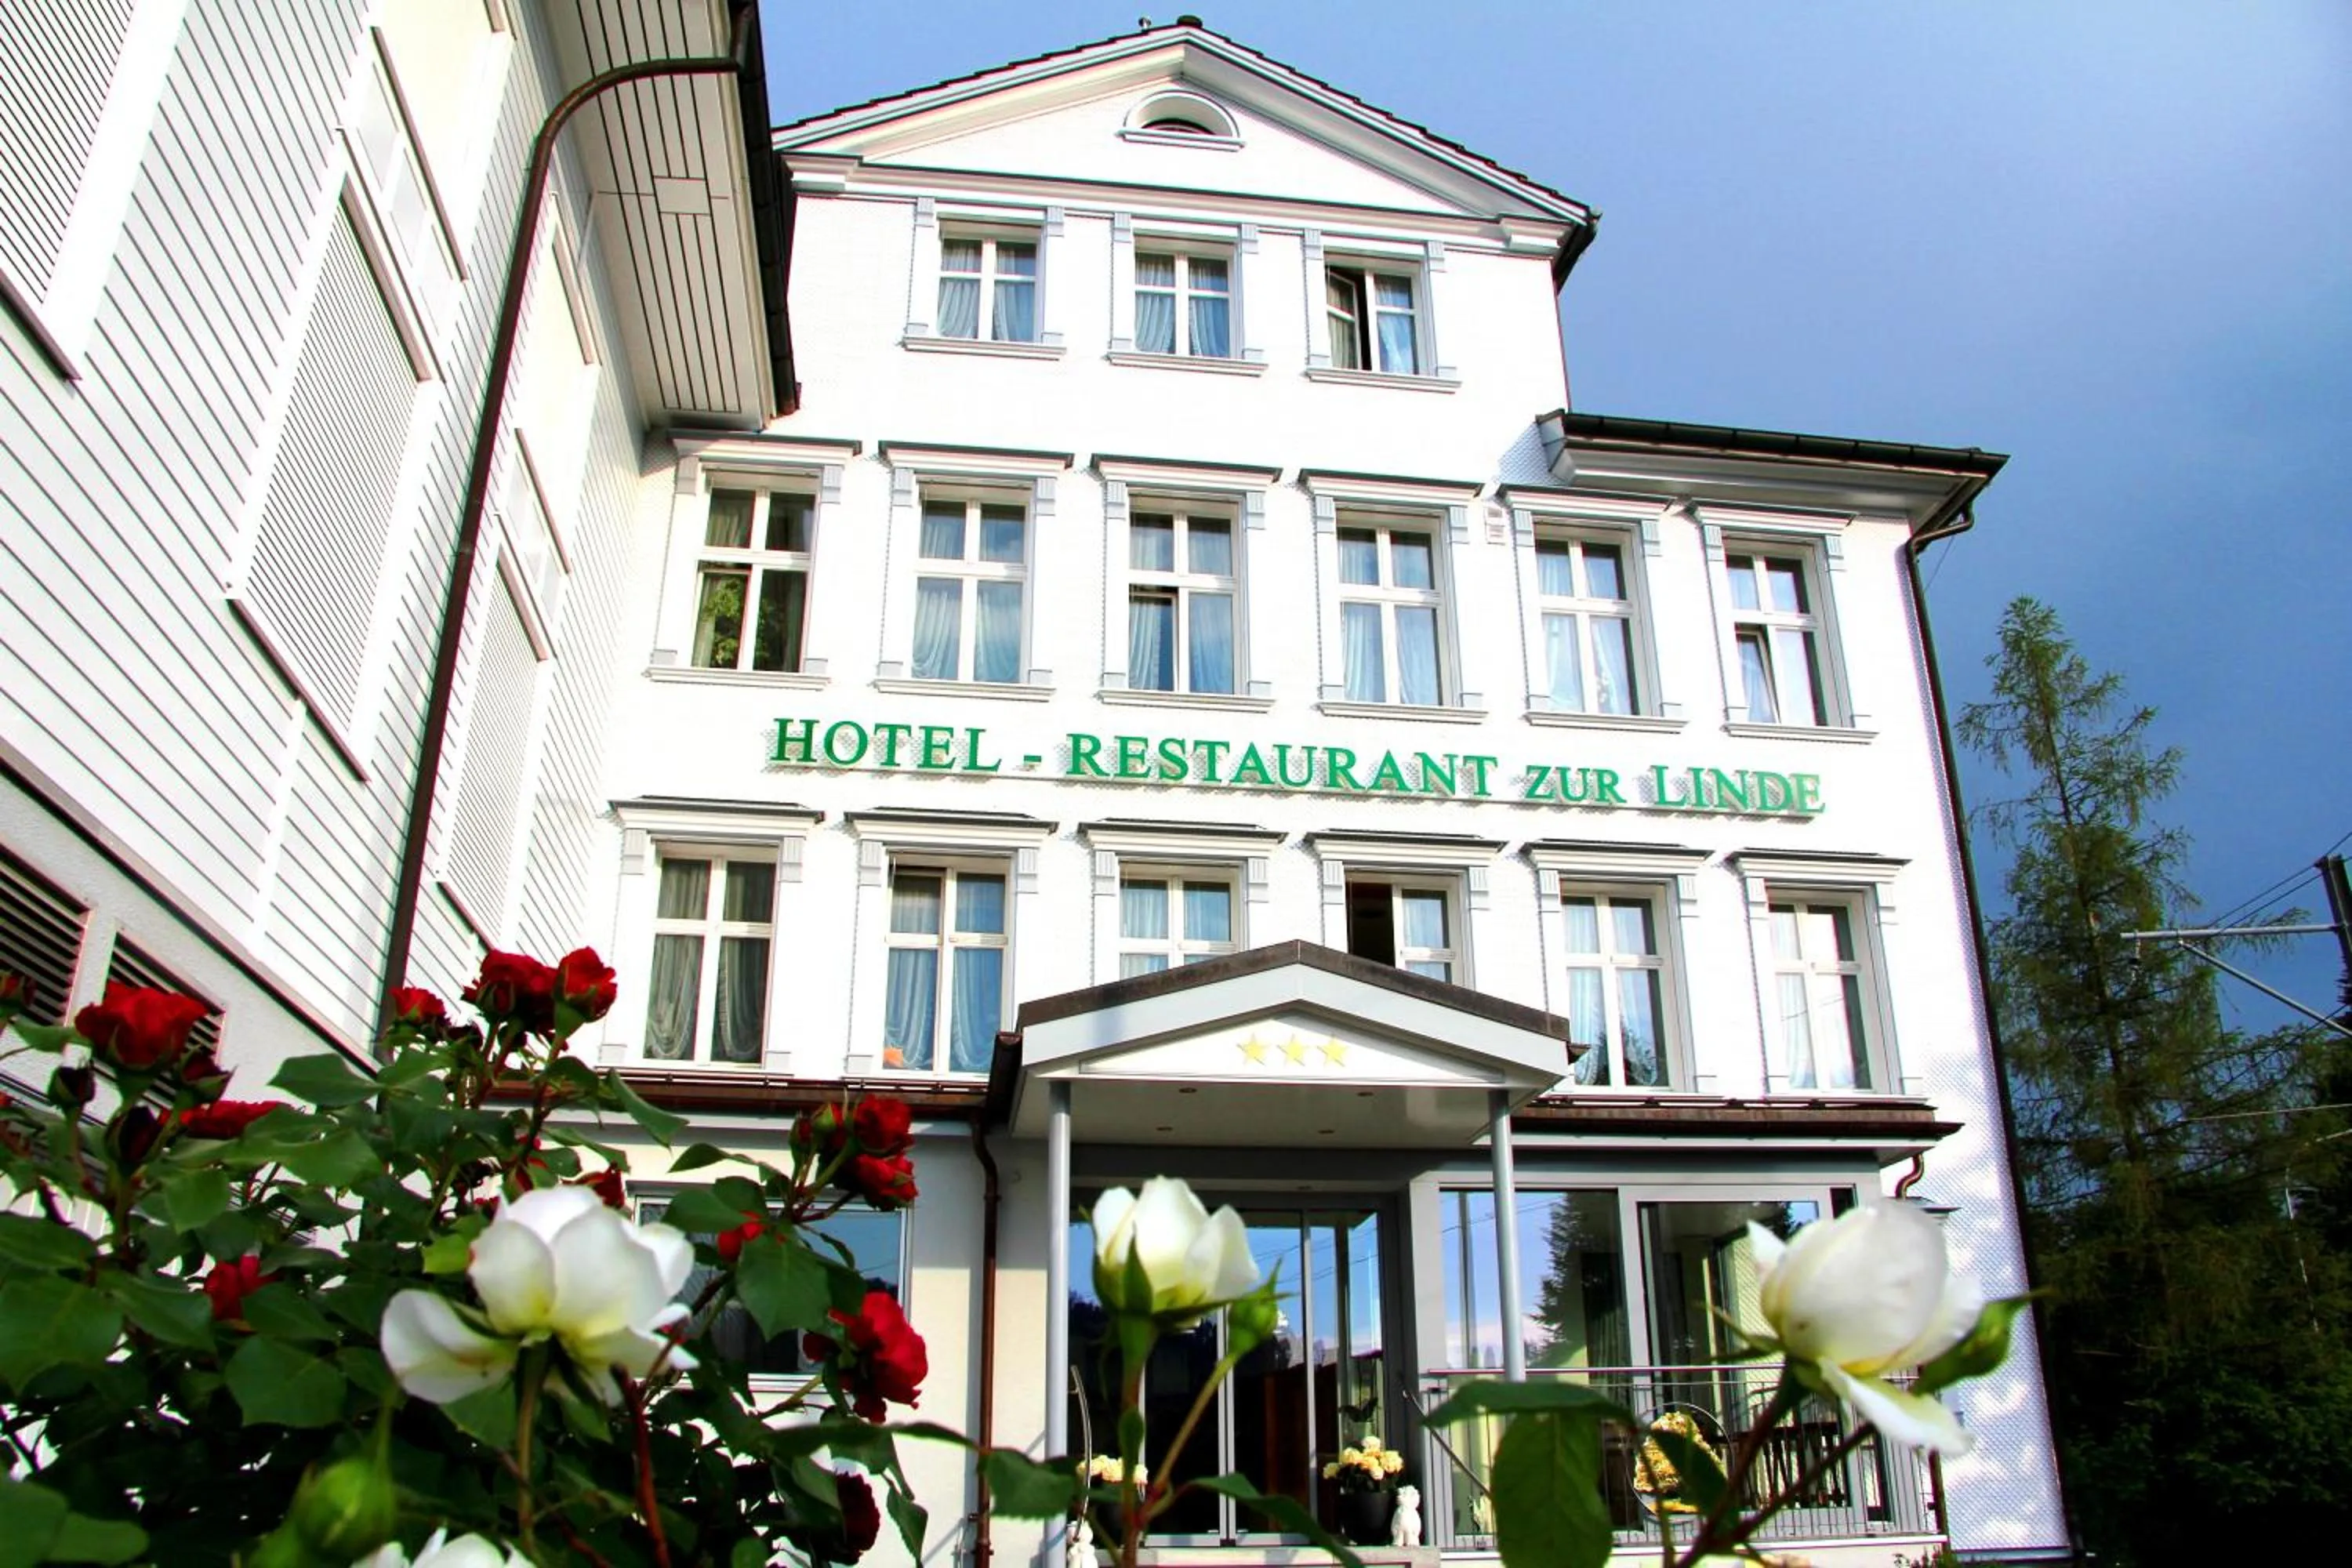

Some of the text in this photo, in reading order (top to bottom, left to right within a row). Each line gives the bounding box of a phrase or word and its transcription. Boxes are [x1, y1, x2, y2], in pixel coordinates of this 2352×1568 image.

[770, 717, 1002, 772] HOTEL
[1065, 732, 1498, 797] RESTAURANT
[1525, 764, 1627, 804] ZUR
[1652, 764, 1827, 815] LINDE
